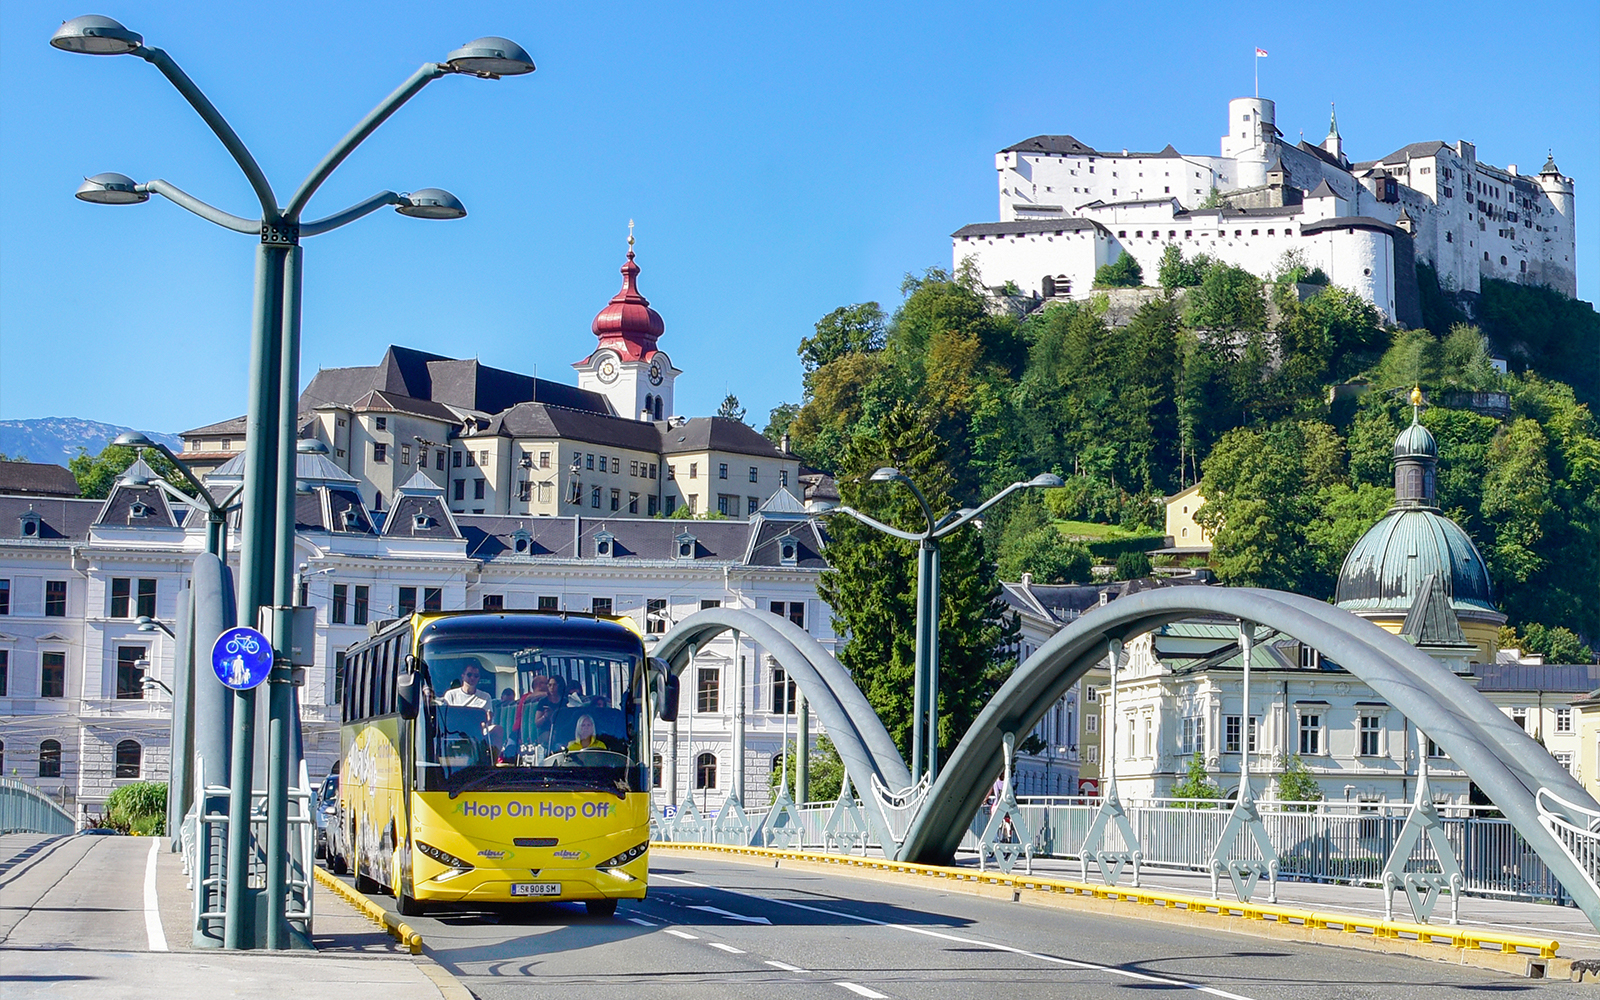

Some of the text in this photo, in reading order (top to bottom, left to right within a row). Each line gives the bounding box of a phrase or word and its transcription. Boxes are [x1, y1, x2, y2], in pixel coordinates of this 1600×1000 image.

[463, 800, 610, 821] Hop On Hop Off
[530, 884, 545, 893] 908
[546, 885, 557, 893] SM
